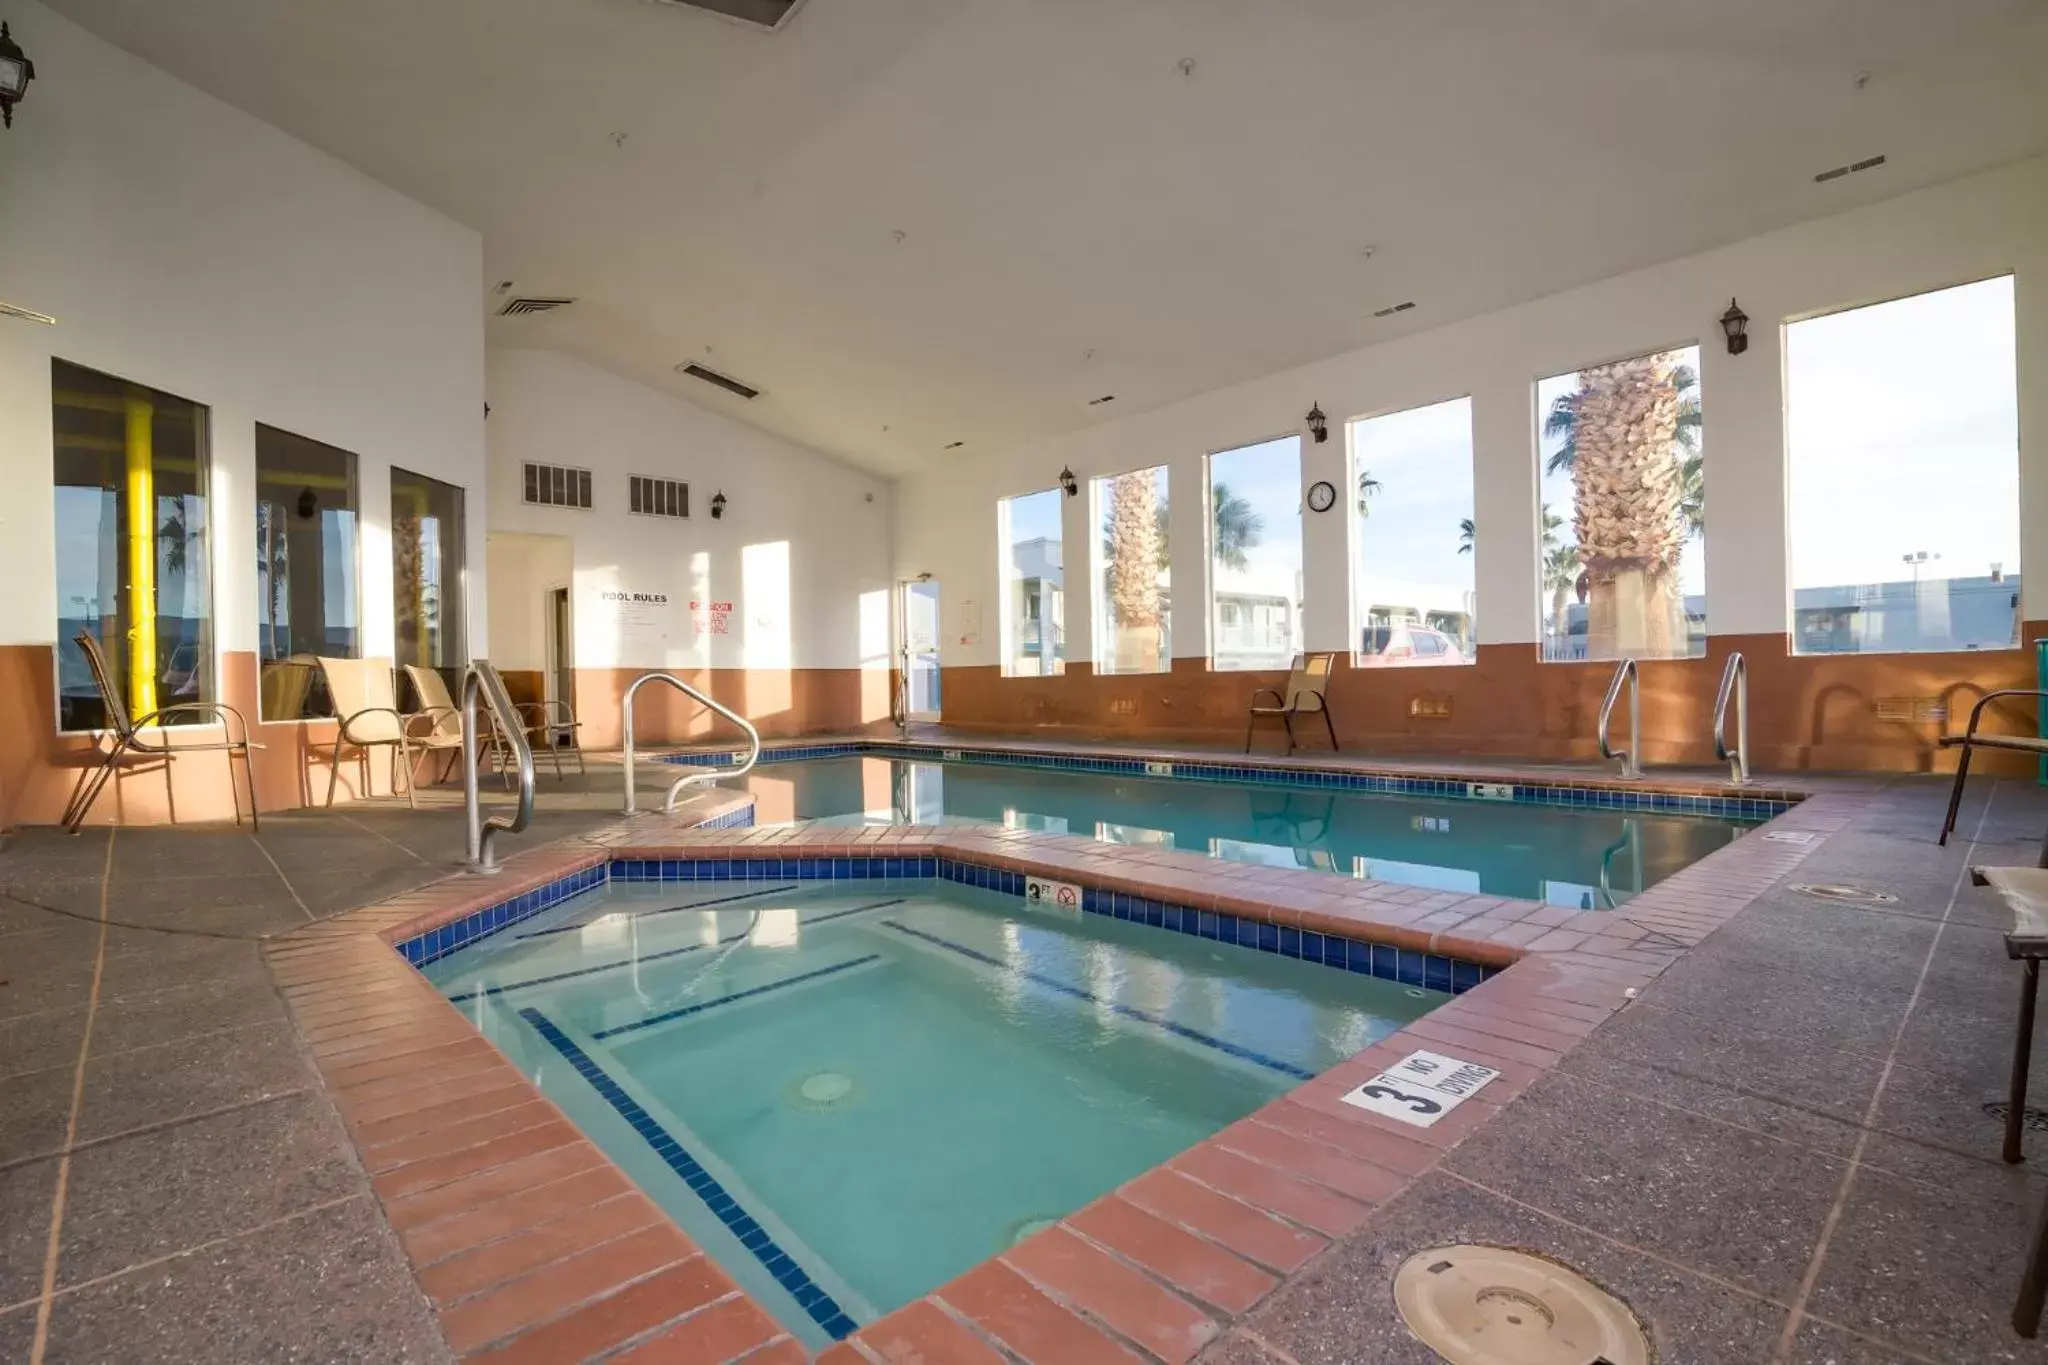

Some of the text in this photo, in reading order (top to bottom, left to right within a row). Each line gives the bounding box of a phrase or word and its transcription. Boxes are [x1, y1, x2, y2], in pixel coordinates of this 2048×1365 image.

[633, 593, 667, 602] RULES
[1402, 1059, 1439, 1075] NO
[1435, 1064, 1492, 1095] DIVING
[1362, 1085, 1443, 1114] 3
